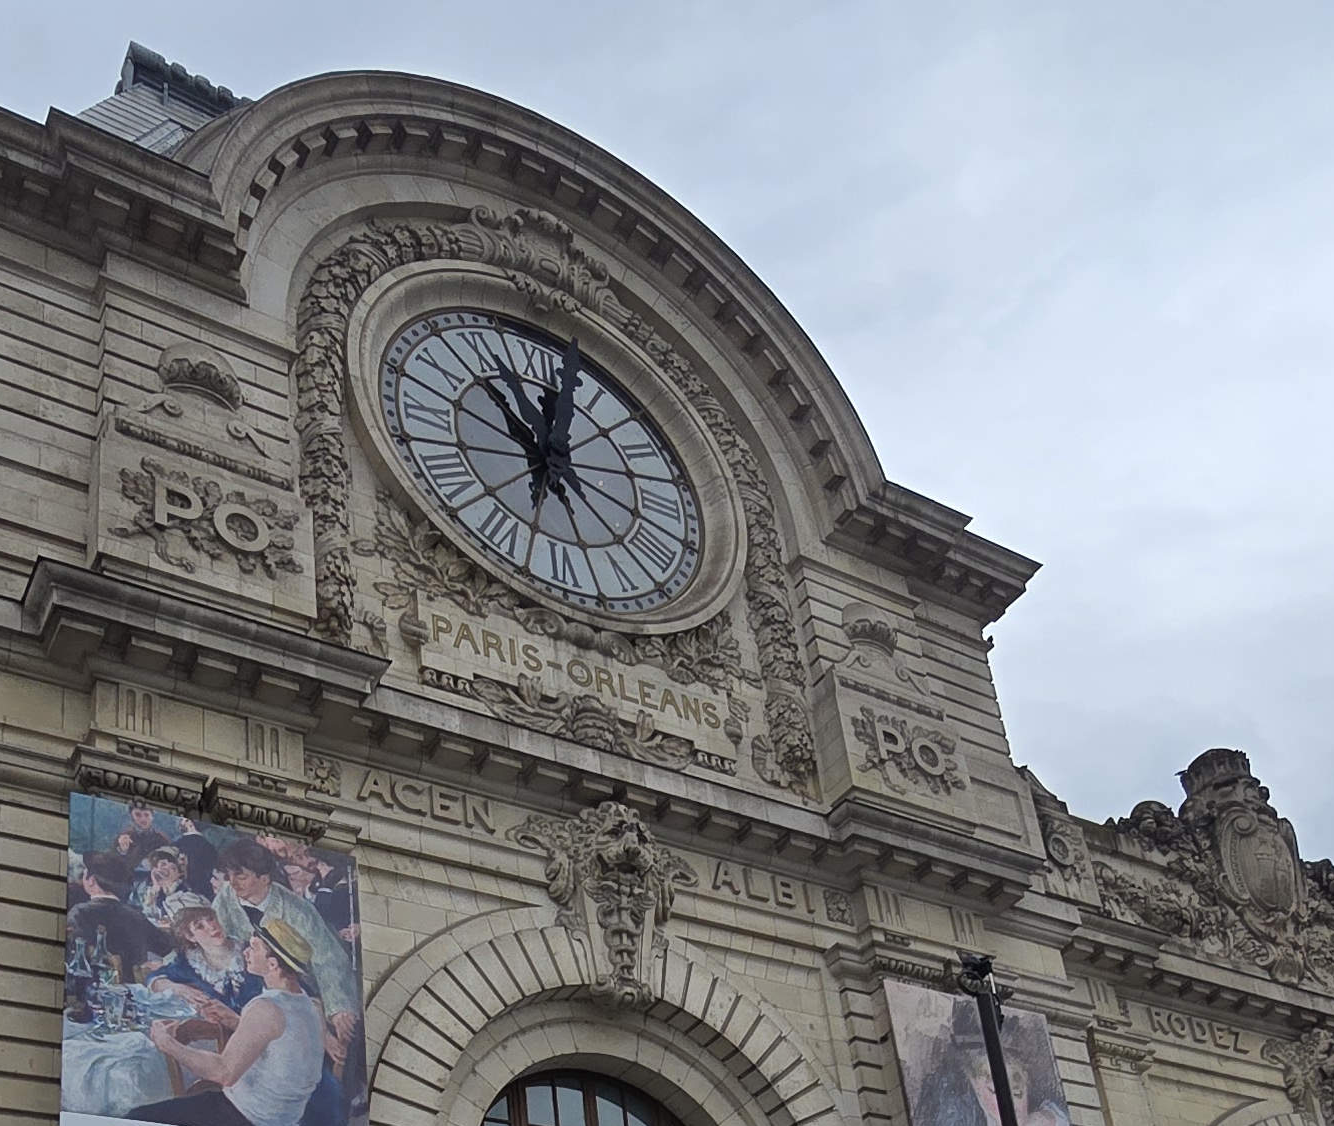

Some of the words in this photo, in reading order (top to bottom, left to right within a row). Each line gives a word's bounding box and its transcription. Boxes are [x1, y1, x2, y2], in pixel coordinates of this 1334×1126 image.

[415, 347, 466, 392] X
[460, 331, 499, 374] XI
[517, 339, 562, 390] XII
[404, 391, 453, 435] IX
[583, 386, 607, 414] I
[619, 441, 660, 462] II
[420, 451, 477, 502] VIII
[639, 486, 682, 524] III
[477, 502, 519, 559] VII
[628, 523, 677, 573] IIII
[547, 540, 583, 589] VI
[605, 551, 640, 592] V
[356, 770, 497, 835] AGEN
[711, 860, 816, 914] ALBI
[1145, 1005, 1250, 1056] RODEZ
